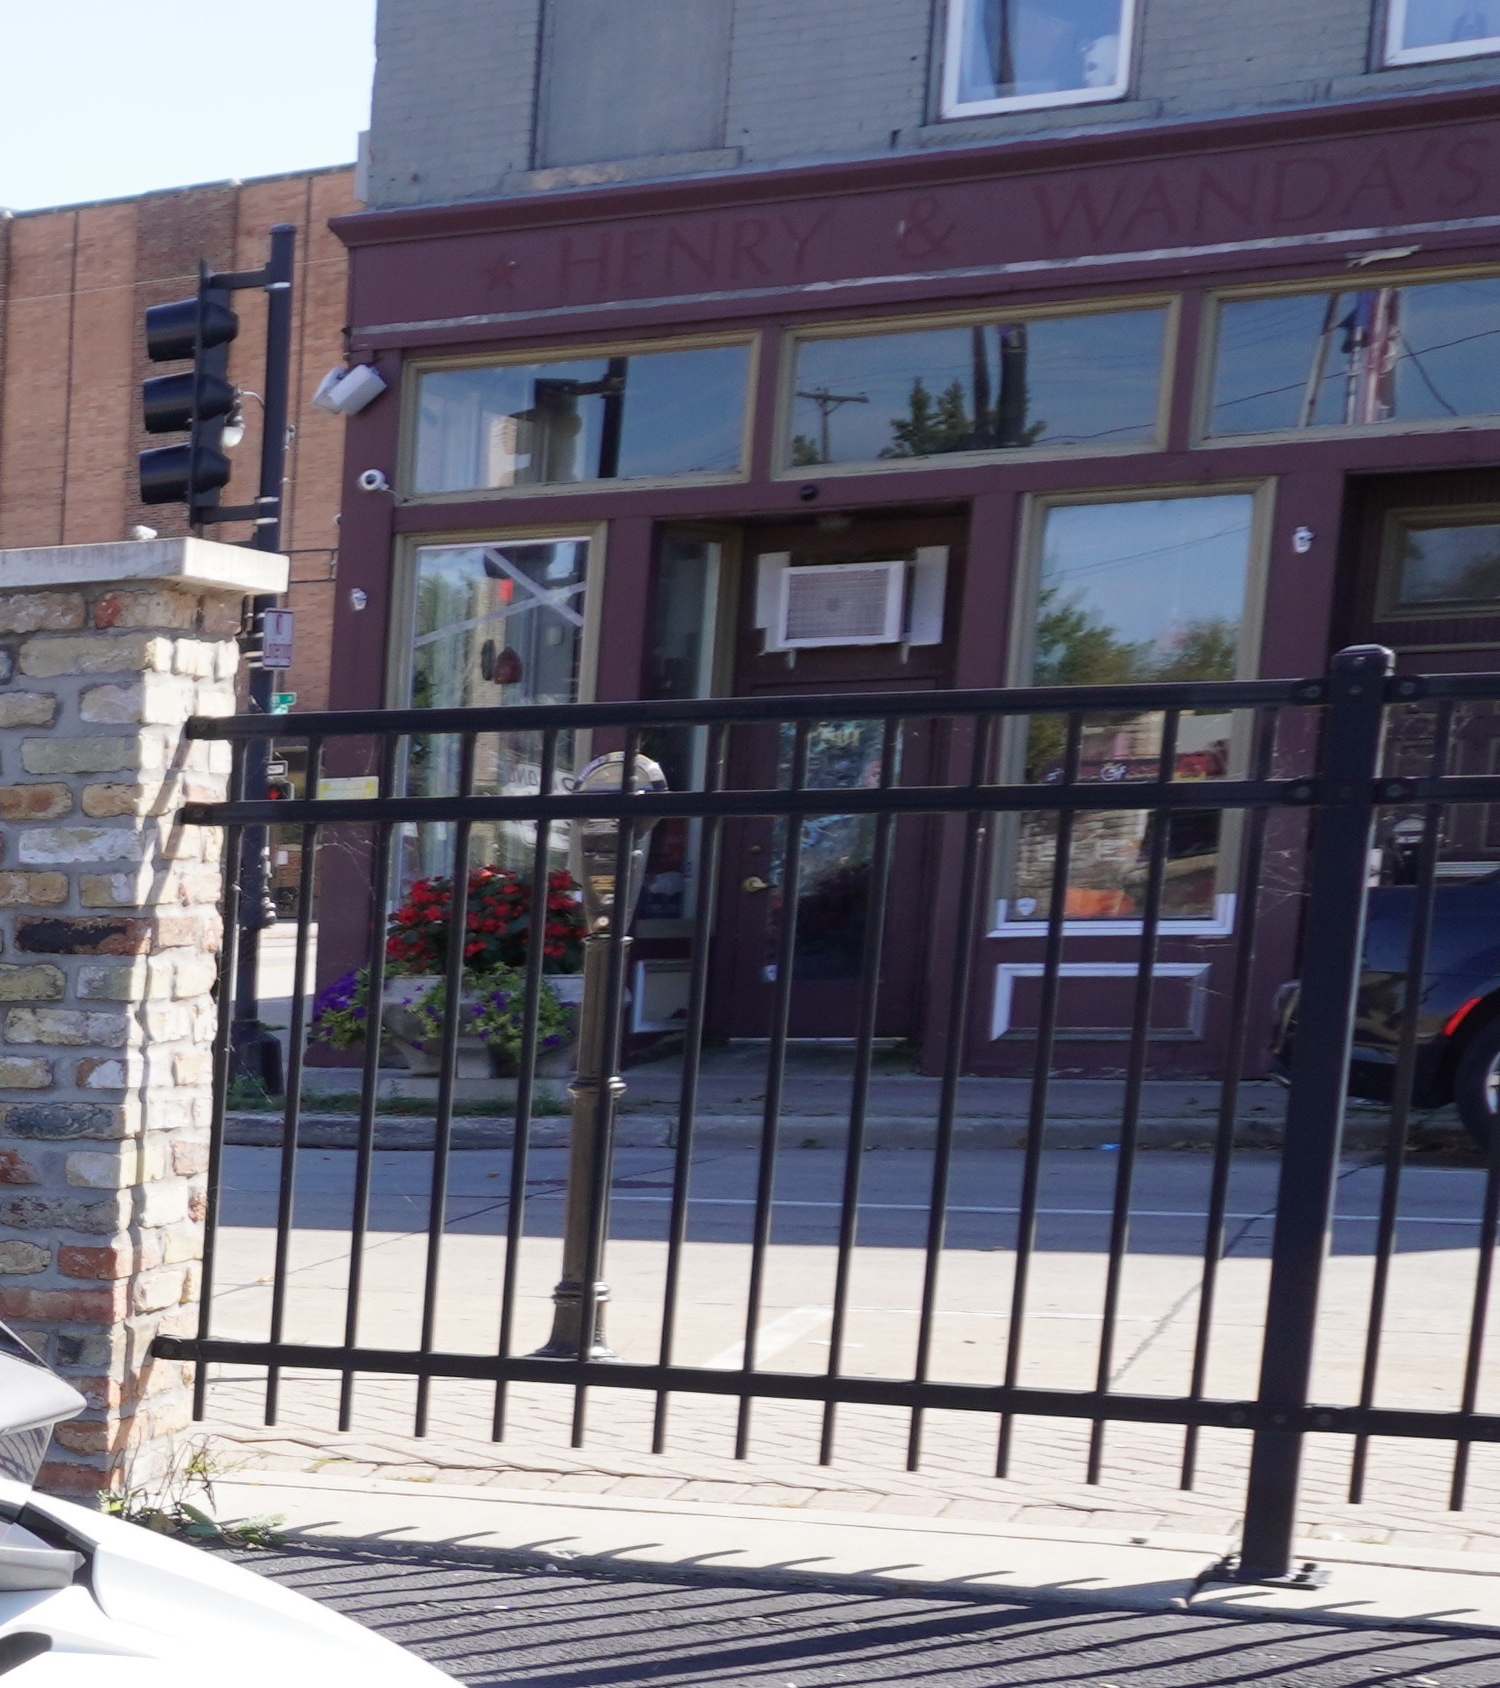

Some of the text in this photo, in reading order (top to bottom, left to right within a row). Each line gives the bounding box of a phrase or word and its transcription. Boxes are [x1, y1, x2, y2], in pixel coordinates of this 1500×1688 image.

[558, 136, 1490, 293] HENRY & WANDA'S
